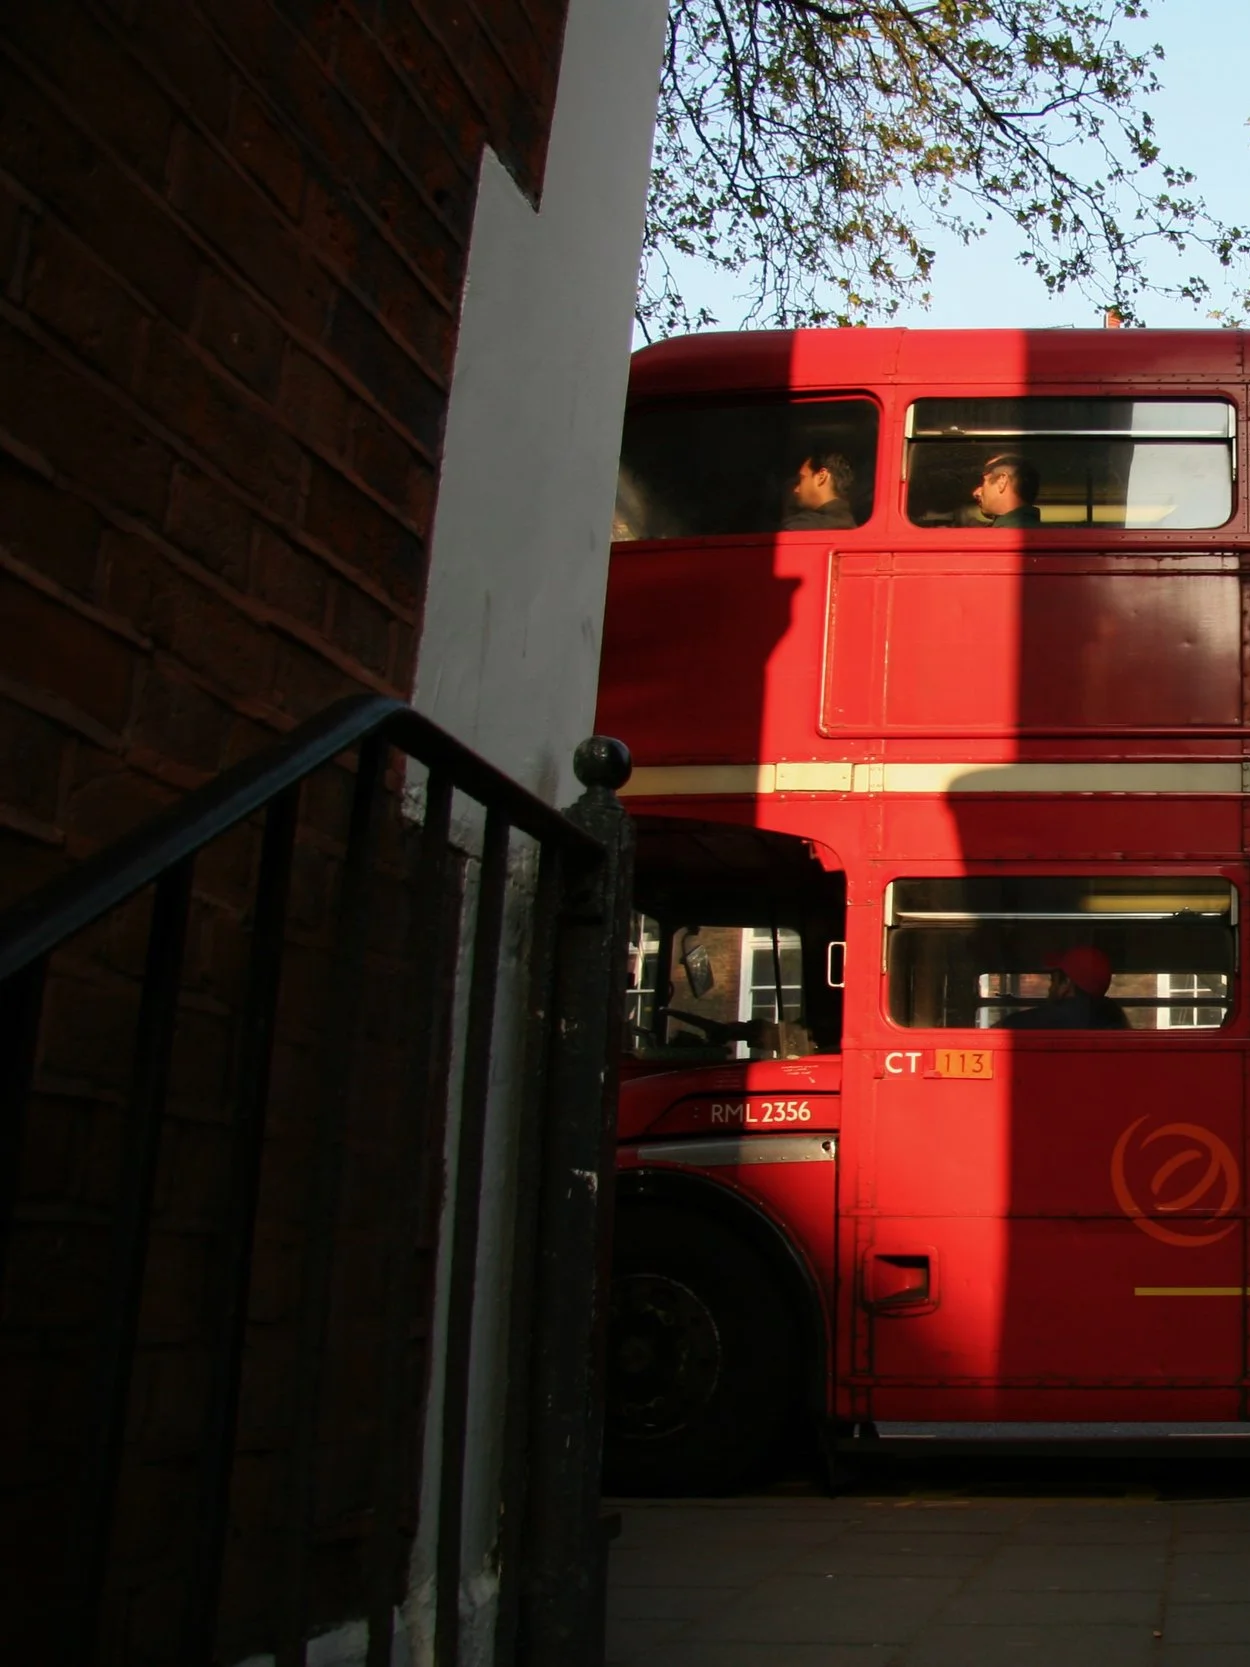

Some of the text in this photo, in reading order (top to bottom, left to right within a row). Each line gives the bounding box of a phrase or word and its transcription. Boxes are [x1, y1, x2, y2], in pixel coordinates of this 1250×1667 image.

[885, 1052, 921, 1073] CT
[944, 1053, 983, 1073] 113
[711, 1101, 811, 1123] RML 2356
